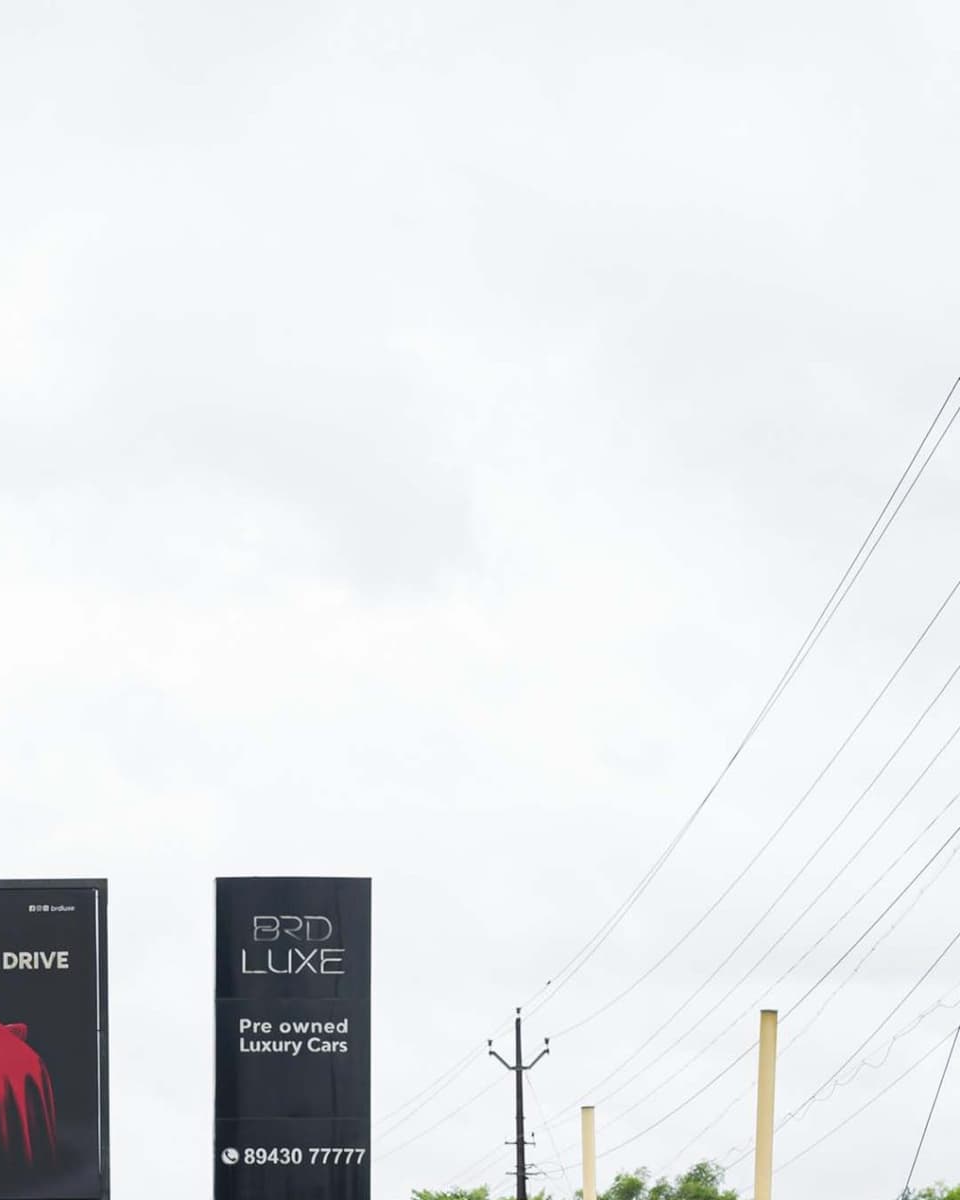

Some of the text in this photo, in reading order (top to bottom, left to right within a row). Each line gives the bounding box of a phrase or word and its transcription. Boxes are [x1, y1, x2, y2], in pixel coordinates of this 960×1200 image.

[253, 915, 333, 942] BRD
[2, 950, 69, 969] DRIVE
[241, 948, 346, 975] LUXE
[239, 1018, 349, 1034] Pre owned
[239, 1036, 349, 1057] Luxury Cars
[244, 1147, 366, 1165] 89430 77777
